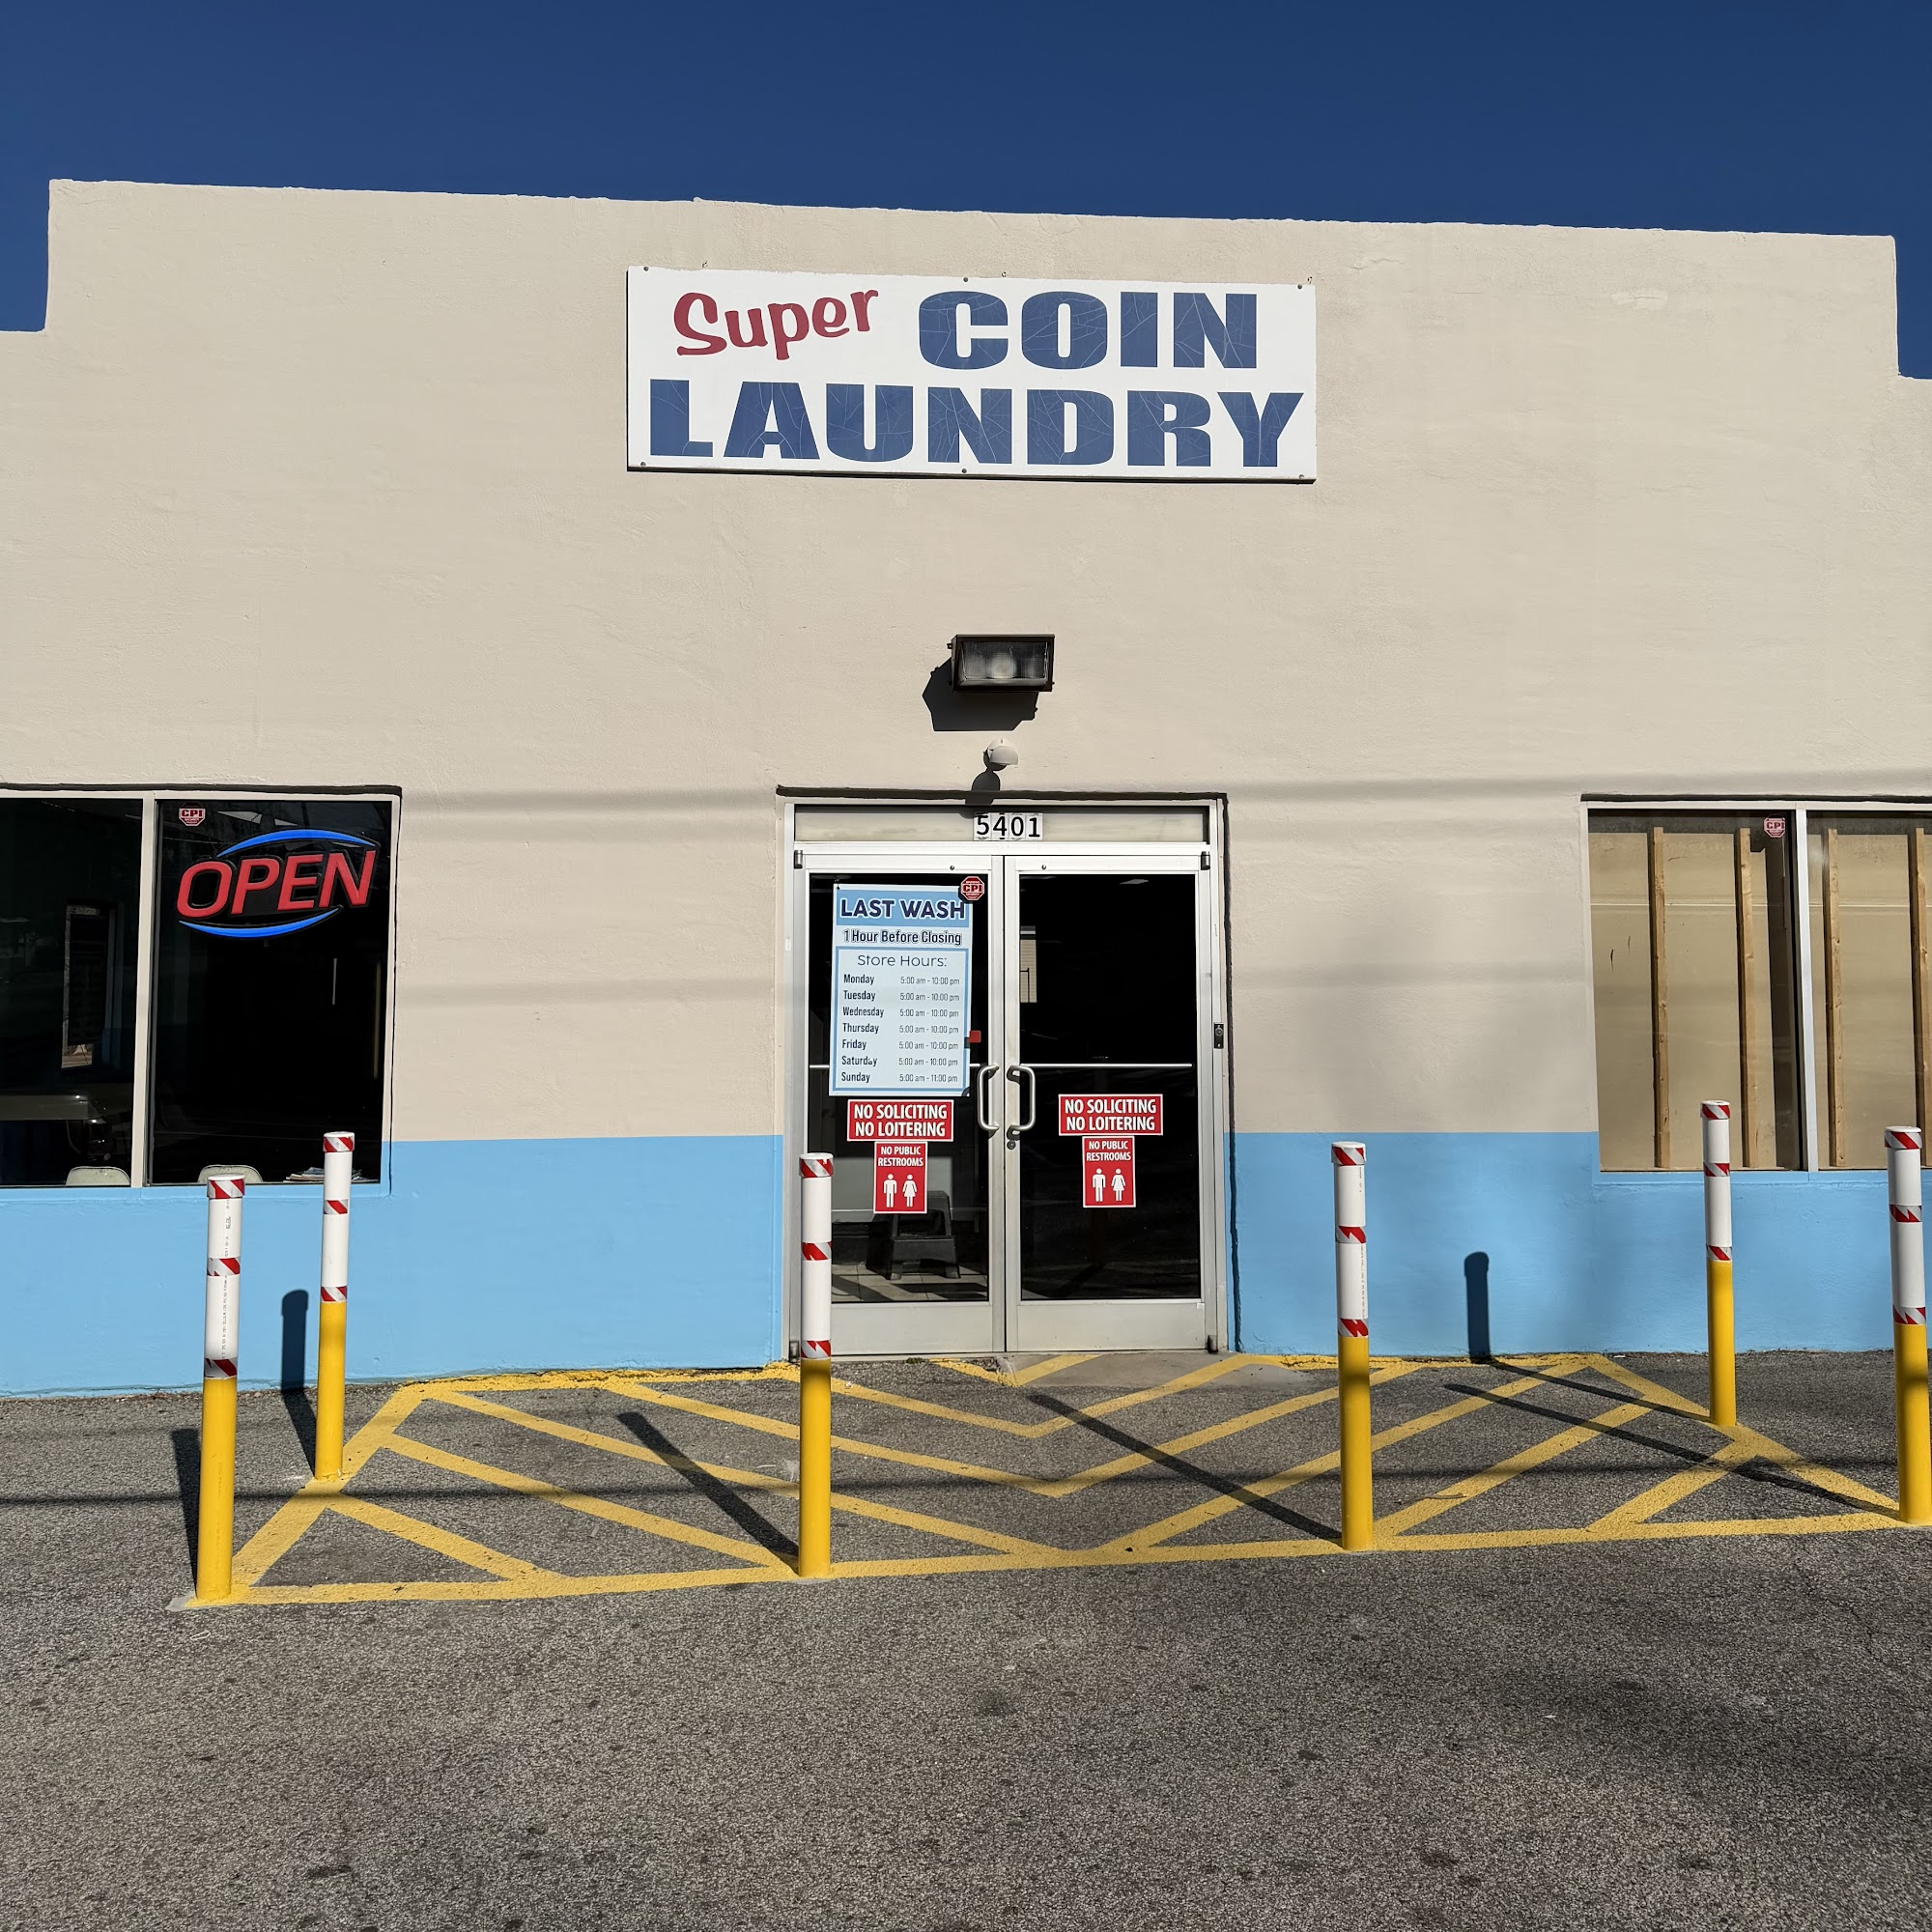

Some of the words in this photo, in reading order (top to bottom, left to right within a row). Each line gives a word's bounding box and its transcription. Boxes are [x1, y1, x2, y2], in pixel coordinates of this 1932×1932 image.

[673, 288, 879, 360] Super
[918, 291, 1257, 370] COIN
[649, 378, 1304, 467] LAUNDRY
[181, 809, 203, 817] CPI
[976, 814, 1040, 838] 5401
[176, 850, 377, 918] OPEN
[962, 884, 982, 893] CPI
[840, 899, 895, 918] LAST
[900, 899, 965, 919] WASH
[843, 929, 849, 943] 1
[852, 929, 878, 943] Hour
[881, 930, 919, 944] Before
[922, 930, 962, 946] Closing
[857, 954, 895, 966] Store
[900, 955, 948, 967] Hours:
[843, 974, 874, 985] Monday
[900, 976, 915, 984] 5:00
[932, 977, 949, 985] 10:00
[843, 990, 875, 1002] Tuesday
[899, 992, 914, 1001] 5:00
[842, 1007, 884, 1018] Wednesday
[842, 1023, 879, 1035] Thursday
[931, 1025, 947, 1034] 10:00
[841, 1038, 867, 1050] Friday
[898, 1040, 913, 1049] 5:00
[930, 1041, 947, 1050] 10:00
[841, 1055, 877, 1066] Saturday
[841, 1072, 870, 1083] Sunday
[854, 1104, 873, 1119] NO
[876, 1104, 947, 1120] SOLICITING
[1065, 1098, 1084, 1114] NO
[1087, 1098, 1157, 1114] SOLICITING
[855, 1122, 874, 1137] NO
[878, 1122, 946, 1137] LOITERING
[1065, 1116, 1086, 1131] NO
[1089, 1116, 1155, 1131] LOITERING
[880, 1146, 893, 1154] NO
[894, 1146, 921, 1155] PUBLIC
[1089, 1140, 1100, 1150] NO
[1101, 1140, 1128, 1150] PUBLIC
[878, 1157, 923, 1167] RESTROOMS
[1086, 1151, 1131, 1161] RESTROOMS
